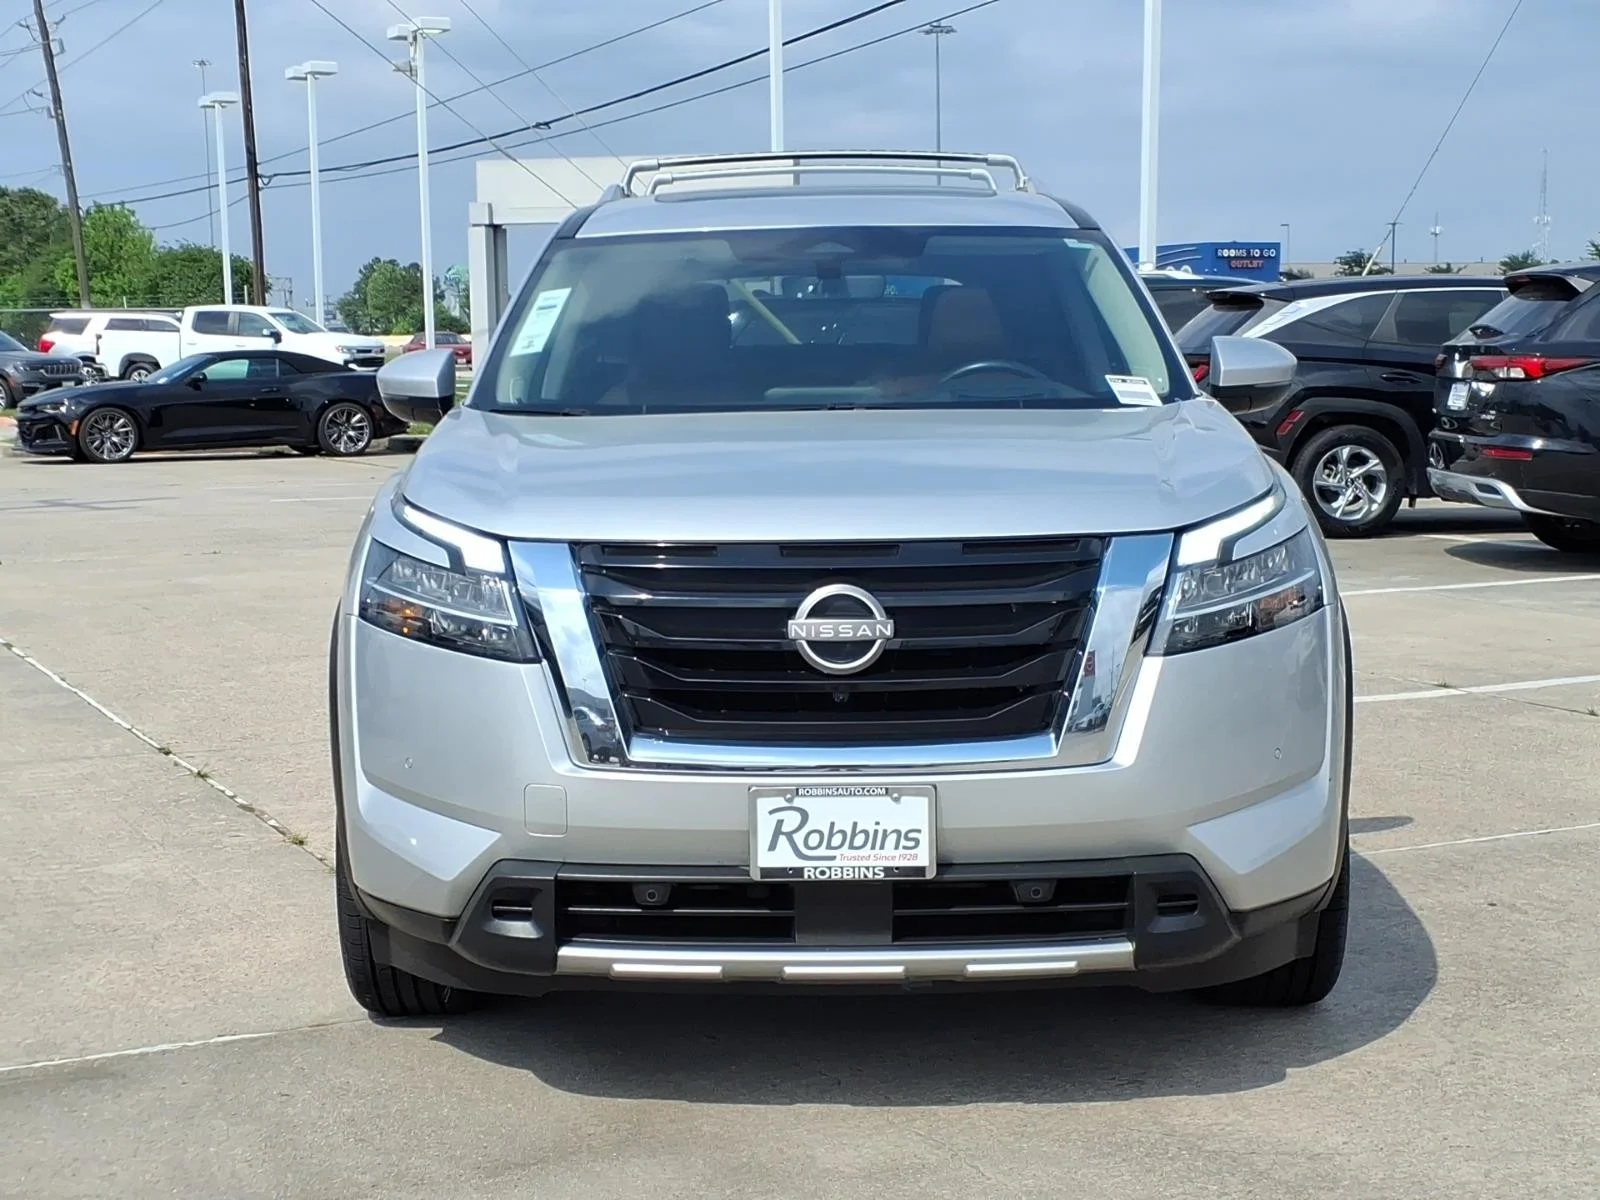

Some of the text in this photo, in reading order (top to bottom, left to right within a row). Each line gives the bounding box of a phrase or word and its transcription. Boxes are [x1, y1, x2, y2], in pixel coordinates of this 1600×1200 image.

[1217, 249, 1276, 257] ROOMS TO GO
[1231, 260, 1264, 268] OUTLET
[791, 624, 891, 637] NISSAN
[798, 787, 886, 796] ROBBINSAUTO.COM
[767, 805, 922, 861] Robbins
[839, 853, 918, 861] Trusted Since 1928
[803, 867, 885, 879] ROBBINS
